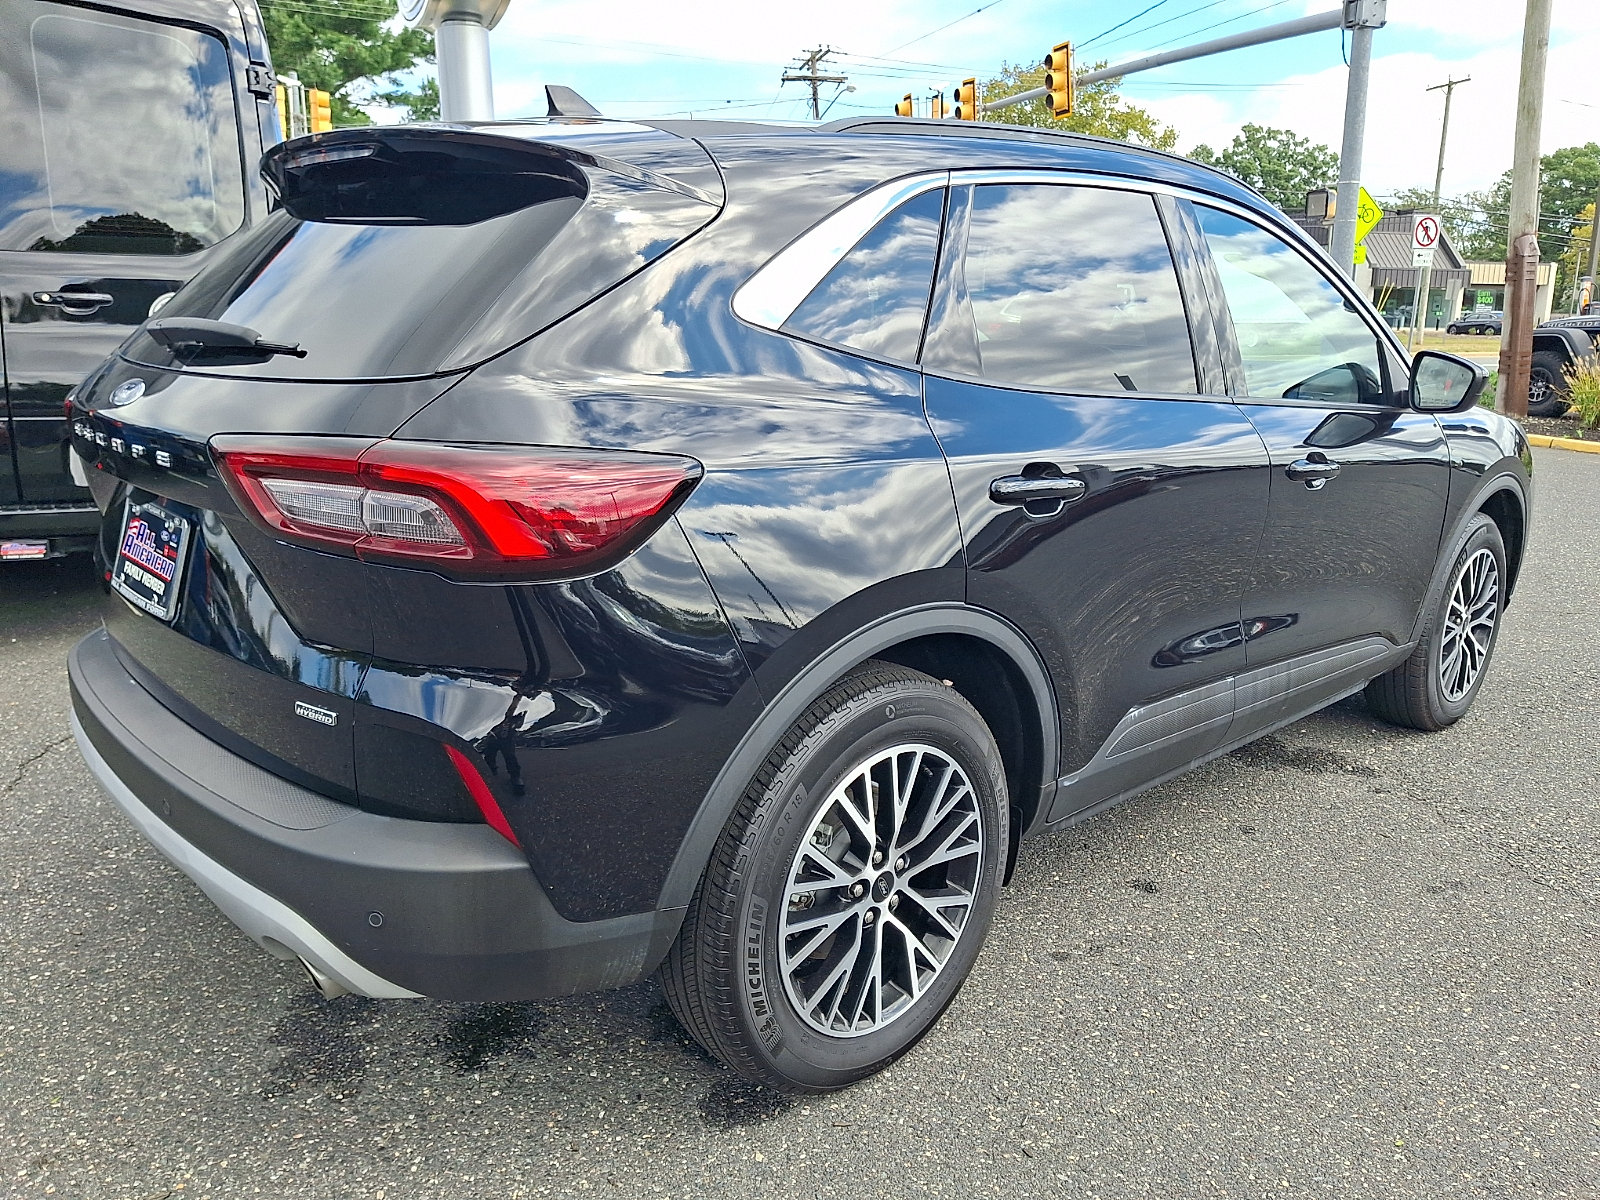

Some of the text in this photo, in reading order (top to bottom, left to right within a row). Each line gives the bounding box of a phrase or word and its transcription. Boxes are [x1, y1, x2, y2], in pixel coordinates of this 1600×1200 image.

[136, 521, 156, 550] ALL
[122, 533, 175, 580] AMERICAN
[124, 560, 166, 596] FAMILY MEMBER
[297, 707, 333, 724] HYBRID
[784, 812, 792, 824] R
[792, 794, 803, 809] 18
[748, 903, 767, 1017] MICHELIN
